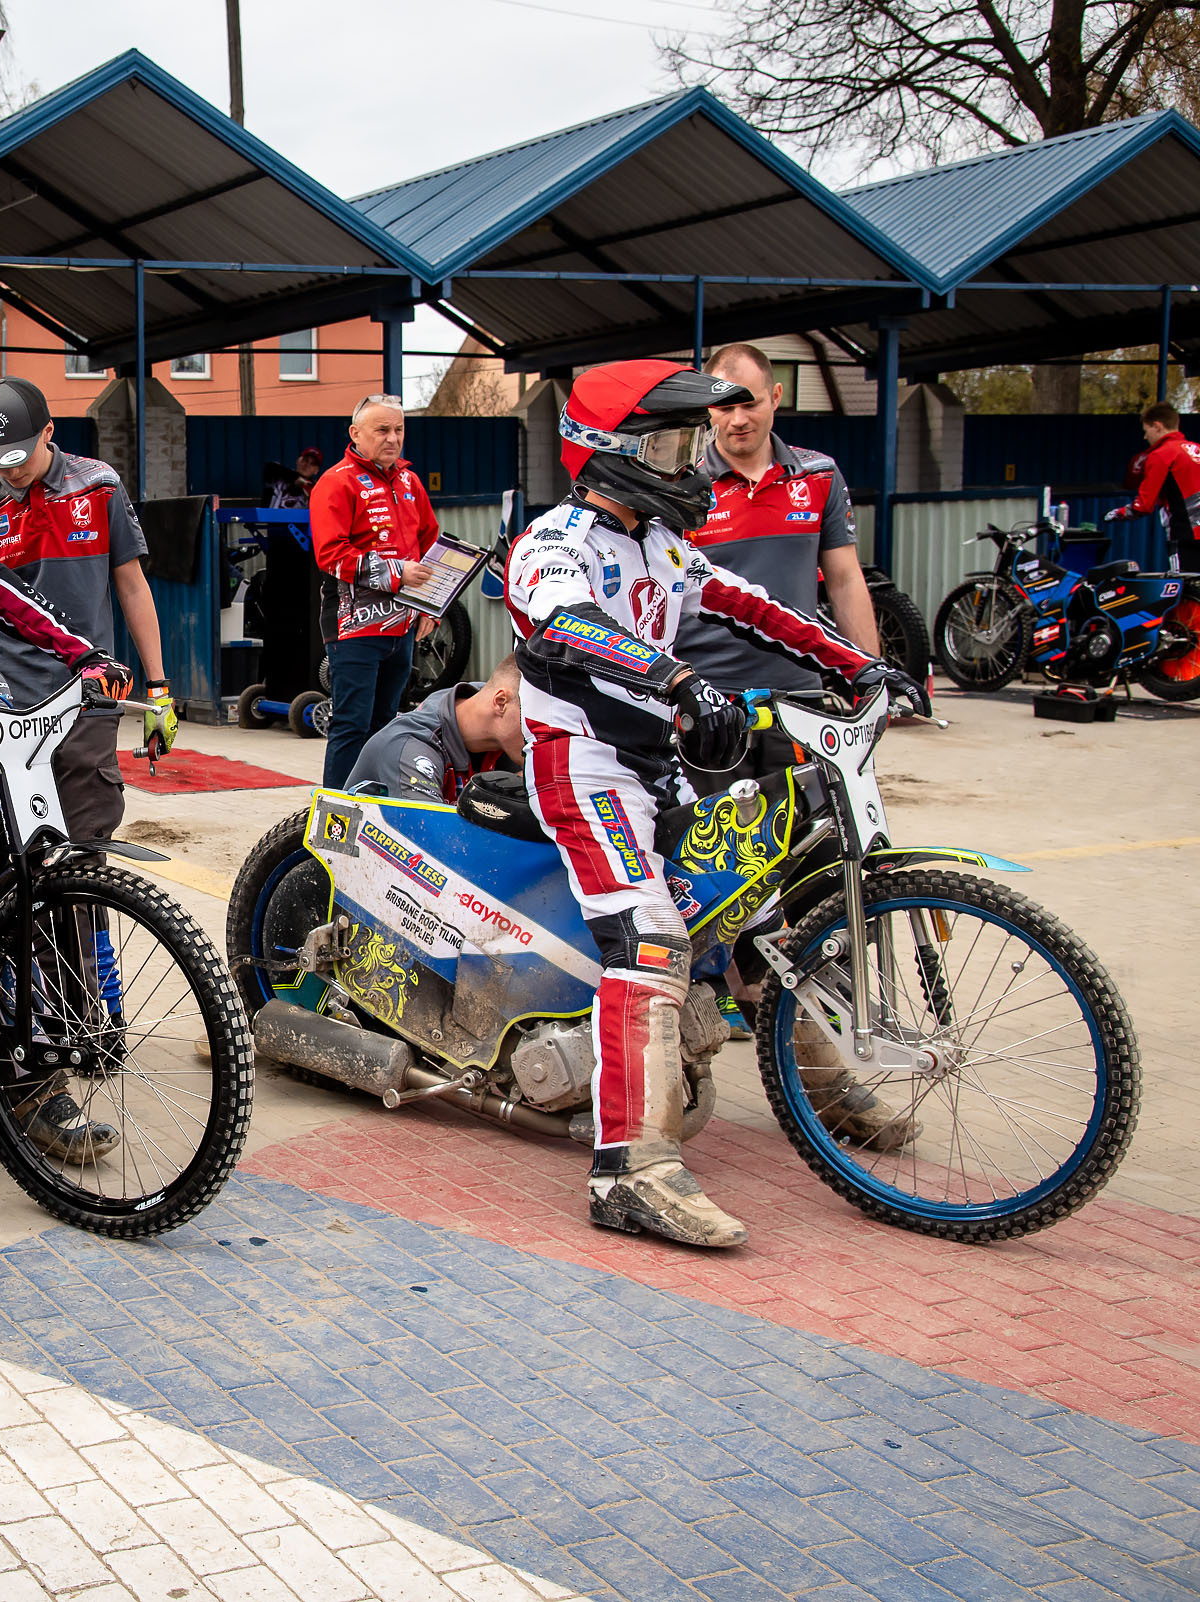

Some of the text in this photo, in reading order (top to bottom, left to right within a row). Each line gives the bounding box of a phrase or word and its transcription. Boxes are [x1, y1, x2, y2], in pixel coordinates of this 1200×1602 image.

[707, 510, 731, 521] PTIBET
[1161, 582, 1180, 598] 12
[553, 614, 654, 660] CARPETS 4 LESS
[8, 714, 64, 740] OPTIBET
[596, 796, 616, 821] LESS
[363, 823, 447, 888] CARPETS 4 LESS
[384, 889, 463, 950] BRISBANE ROOF TILING
[400, 916, 435, 946] SUPPLIES
[461, 891, 534, 946] daytona
